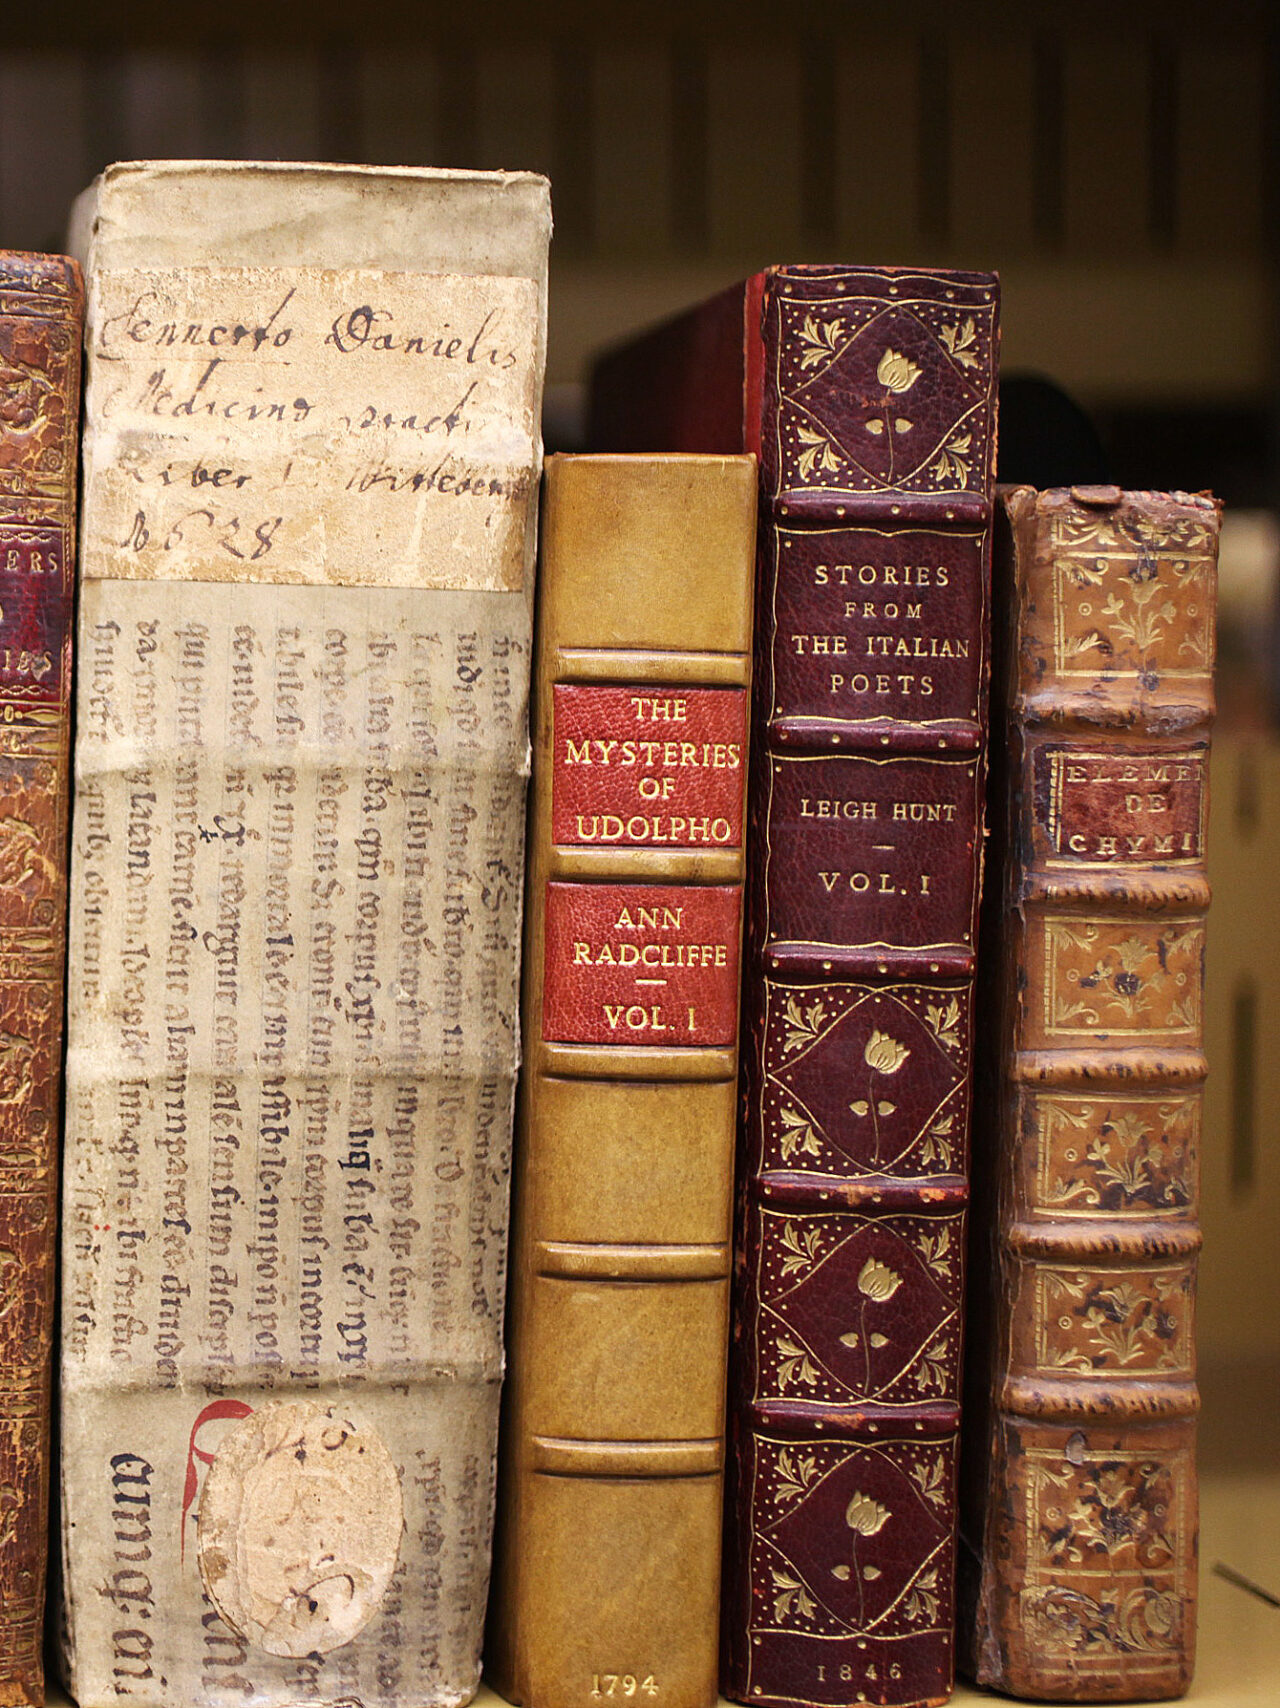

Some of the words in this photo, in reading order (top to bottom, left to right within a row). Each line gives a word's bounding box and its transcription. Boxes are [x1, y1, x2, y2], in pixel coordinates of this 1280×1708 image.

[814, 565, 950, 587] STORIES
[844, 602, 923, 619] FROM
[791, 635, 848, 655] THE
[867, 636, 970, 658] ITALIAN
[830, 674, 934, 695] POETS
[631, 697, 687, 722] THE
[564, 739, 741, 769] MYSTERIES
[638, 777, 676, 800] OF
[800, 799, 877, 820] LEIGH
[893, 804, 958, 822] HUNT
[1125, 793, 1167, 814] DE
[577, 815, 731, 842] UDOLPHO
[819, 872, 908, 895] VOL.
[613, 907, 683, 930] ANN
[572, 942, 728, 967] RADCLIFFE
[603, 1005, 676, 1031] VOL.
[817, 1662, 902, 1682] 1846
[591, 1674, 660, 1698] 1794
